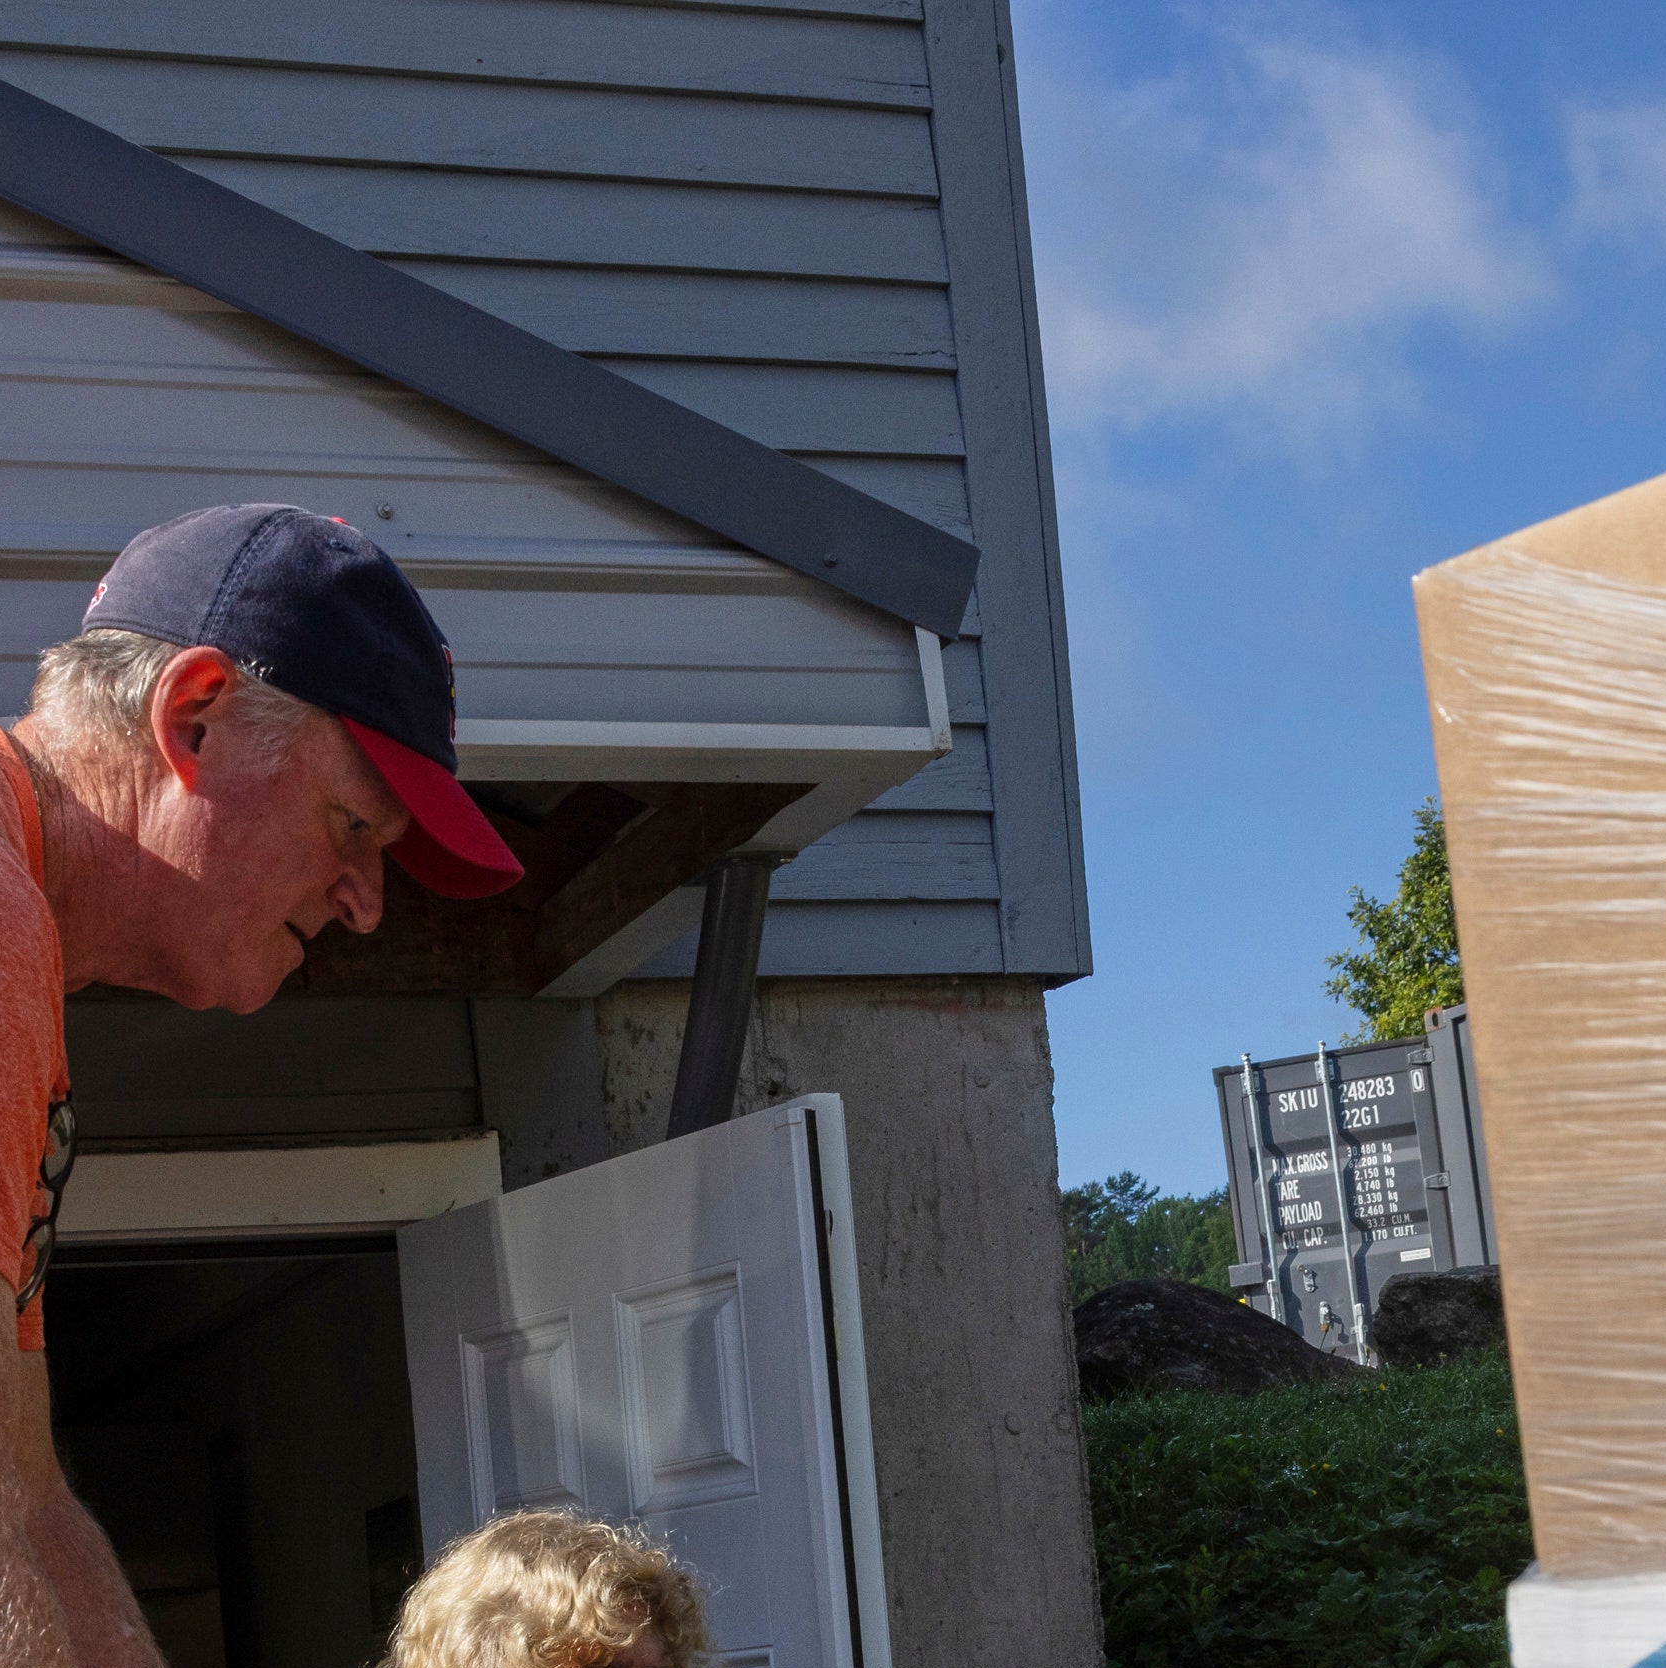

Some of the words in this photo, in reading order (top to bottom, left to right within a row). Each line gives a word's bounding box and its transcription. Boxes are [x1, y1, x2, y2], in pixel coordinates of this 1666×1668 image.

[1278, 1088, 1319, 1113] SKIU
[1338, 1076, 1395, 1104] 248283
[1412, 1070, 1425, 1092] 0
[1341, 1104, 1381, 1130] 22G1
[1346, 1142, 1377, 1158] 30.480
[1381, 1142, 1393, 1154] kg
[1383, 1153, 1392, 1164] lb
[1274, 1179, 1301, 1202] TARE
[1354, 1168, 1380, 1181] 2.150
[1384, 1166, 1396, 1178] kg
[1356, 1180, 1381, 1193] 4.740
[1386, 1178, 1395, 1189] lb
[1278, 1200, 1323, 1226] PAYLOAD
[1352, 1191, 1383, 1206] 28.330
[1387, 1190, 1399, 1203] kg
[1354, 1204, 1384, 1218] 62.460
[1389, 1203, 1398, 1214] lb
[1303, 1226, 1329, 1248] CAP.
[1366, 1217, 1387, 1230] 33.2
